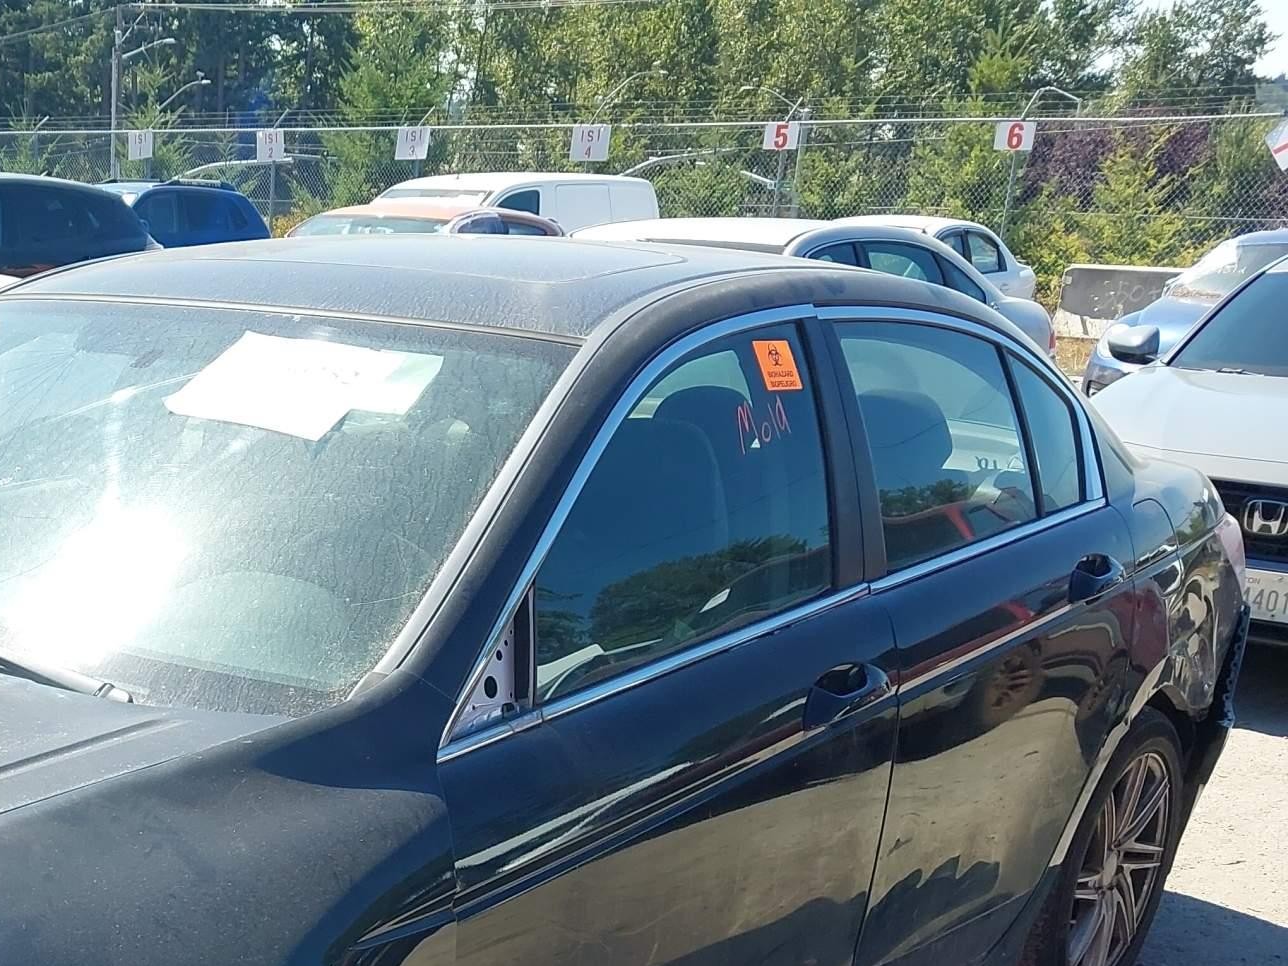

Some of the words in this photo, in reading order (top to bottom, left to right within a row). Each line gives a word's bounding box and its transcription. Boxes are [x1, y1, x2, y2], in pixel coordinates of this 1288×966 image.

[774, 124, 789, 149] 5
[1007, 122, 1025, 149] 6
[584, 145, 592, 158] 4
